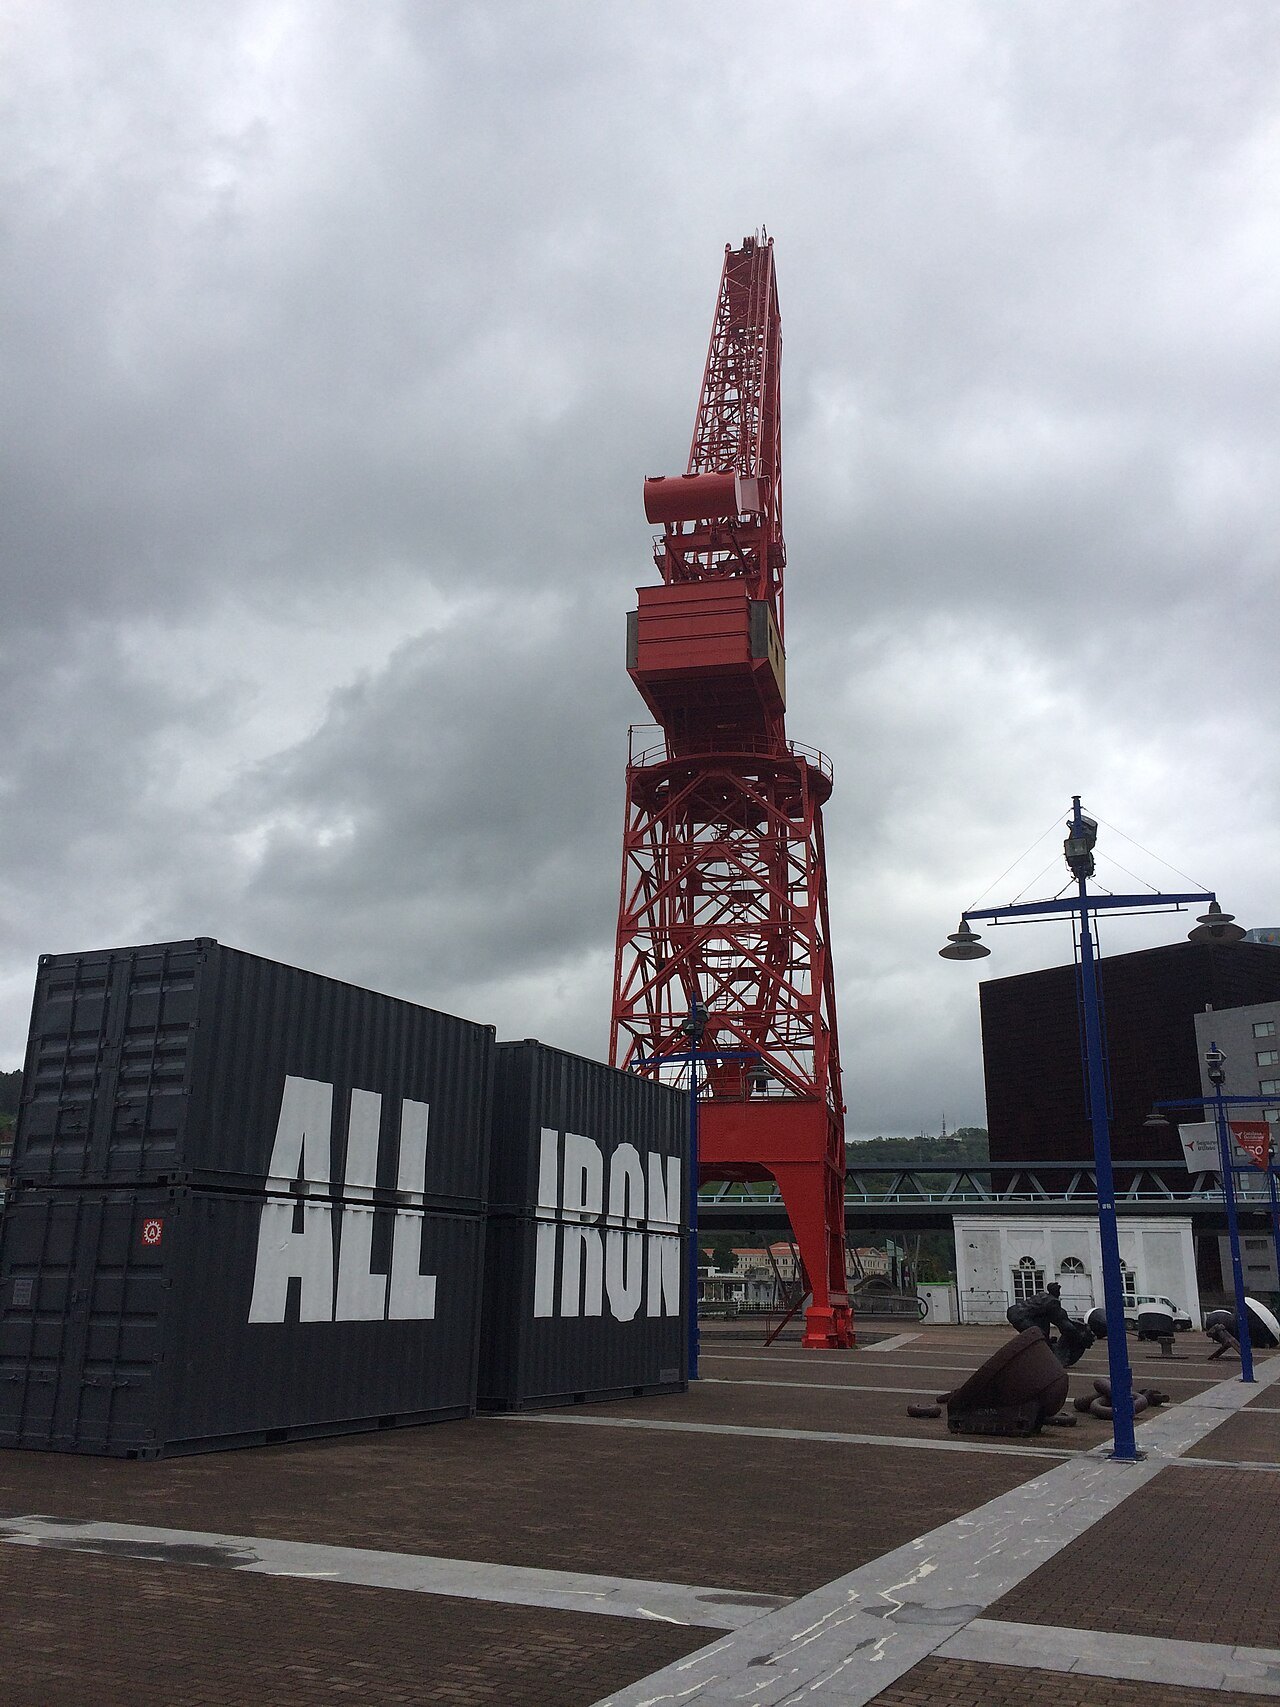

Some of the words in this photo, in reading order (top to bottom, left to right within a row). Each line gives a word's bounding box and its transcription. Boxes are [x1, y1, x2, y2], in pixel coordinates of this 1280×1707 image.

[149, 1228, 156, 1237] A
[248, 1075, 437, 1323] ALL
[534, 1127, 681, 1321] IRON
